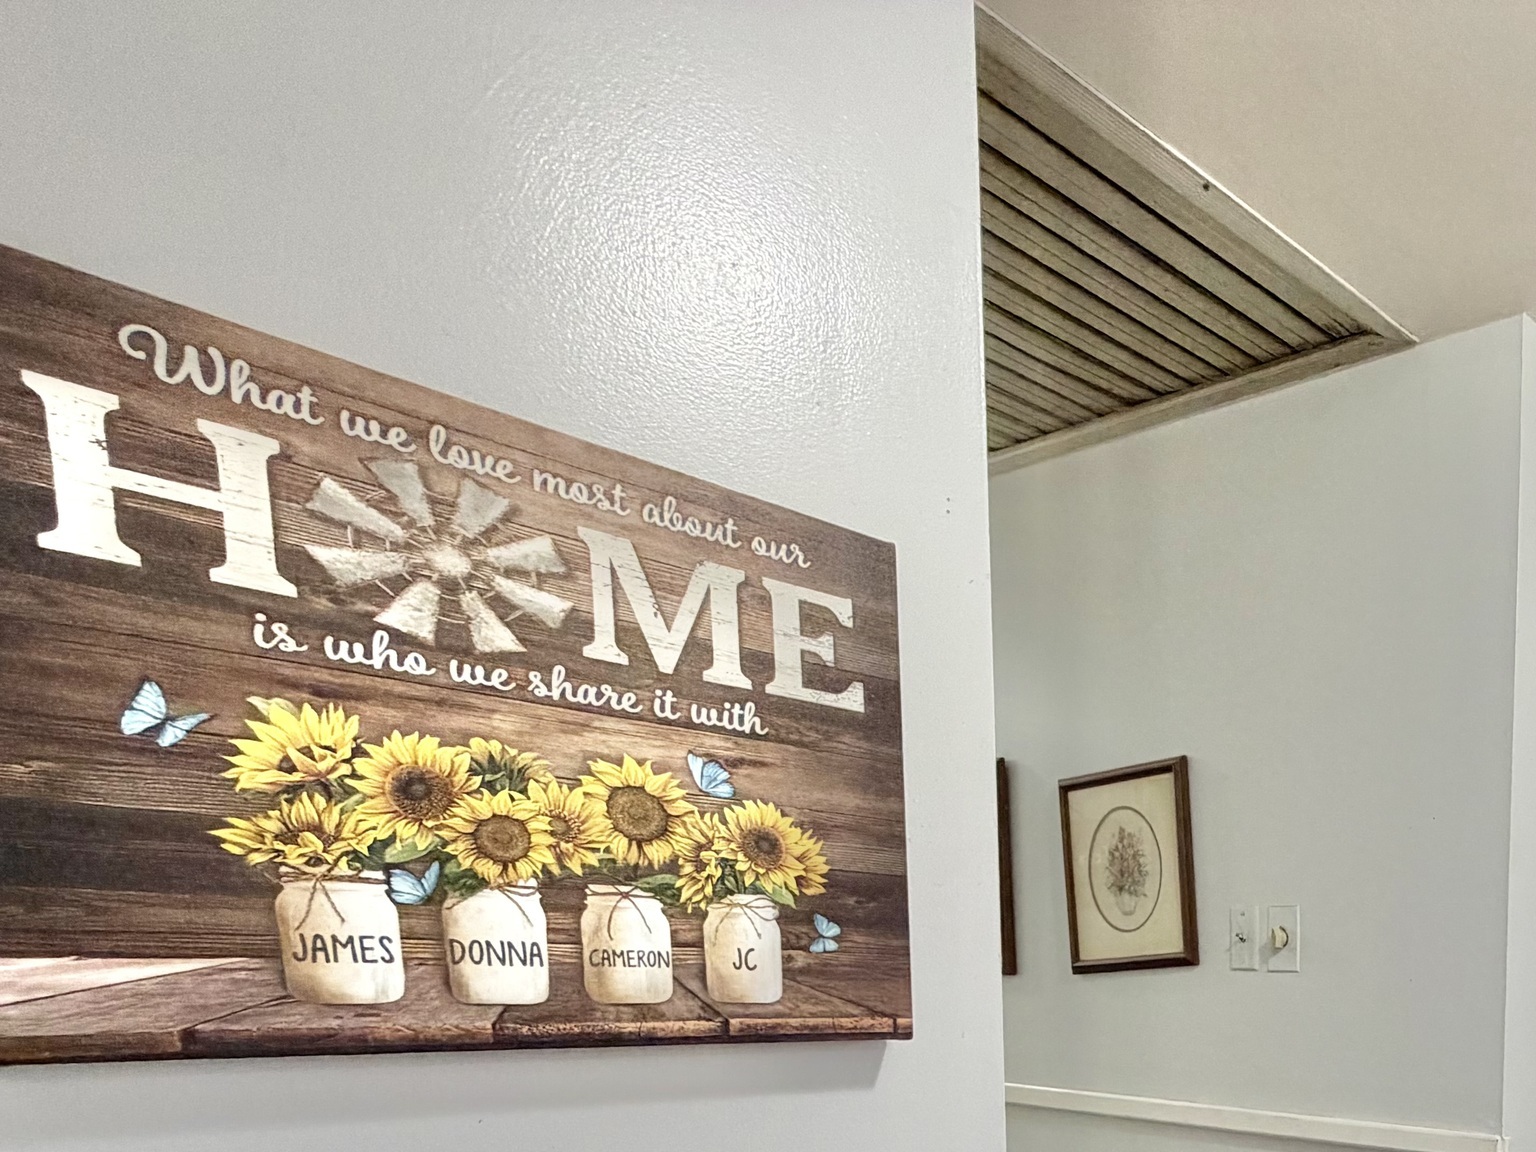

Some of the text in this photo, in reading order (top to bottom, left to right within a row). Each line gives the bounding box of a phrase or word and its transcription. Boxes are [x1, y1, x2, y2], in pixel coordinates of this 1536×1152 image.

[118, 323, 811, 569] What we love most about our
[252, 612, 769, 737] is who we share it with
[291, 933, 395, 965] JAMES
[448, 937, 545, 969] DONNA
[588, 947, 671, 970] CAMERON
[731, 946, 759, 973] JC
